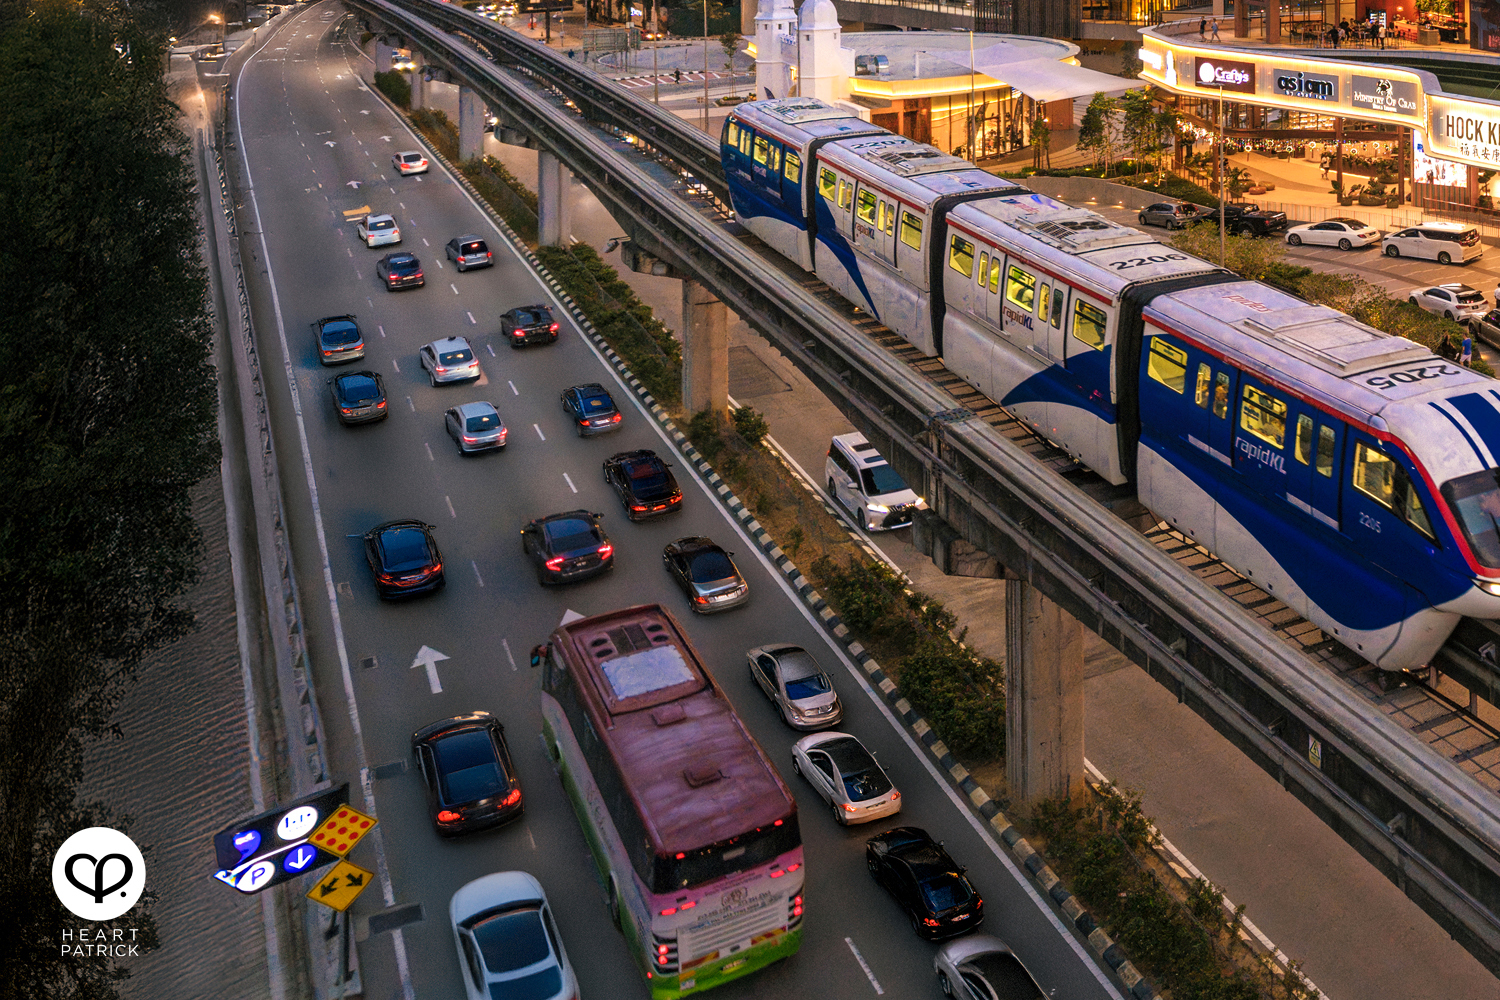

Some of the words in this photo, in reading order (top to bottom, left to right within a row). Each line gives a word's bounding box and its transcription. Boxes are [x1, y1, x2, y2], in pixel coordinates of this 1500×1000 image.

[1215, 66, 1250, 85] Crafty's
[1446, 114, 1484, 143] HOCK
[851, 139, 907, 149] 2207
[1108, 253, 1188, 271] 2206
[1003, 306, 1034, 331] rapidKL
[1366, 364, 1461, 391] 2205
[1235, 436, 1287, 475] rapidKL
[1359, 511, 1382, 534] 2205
